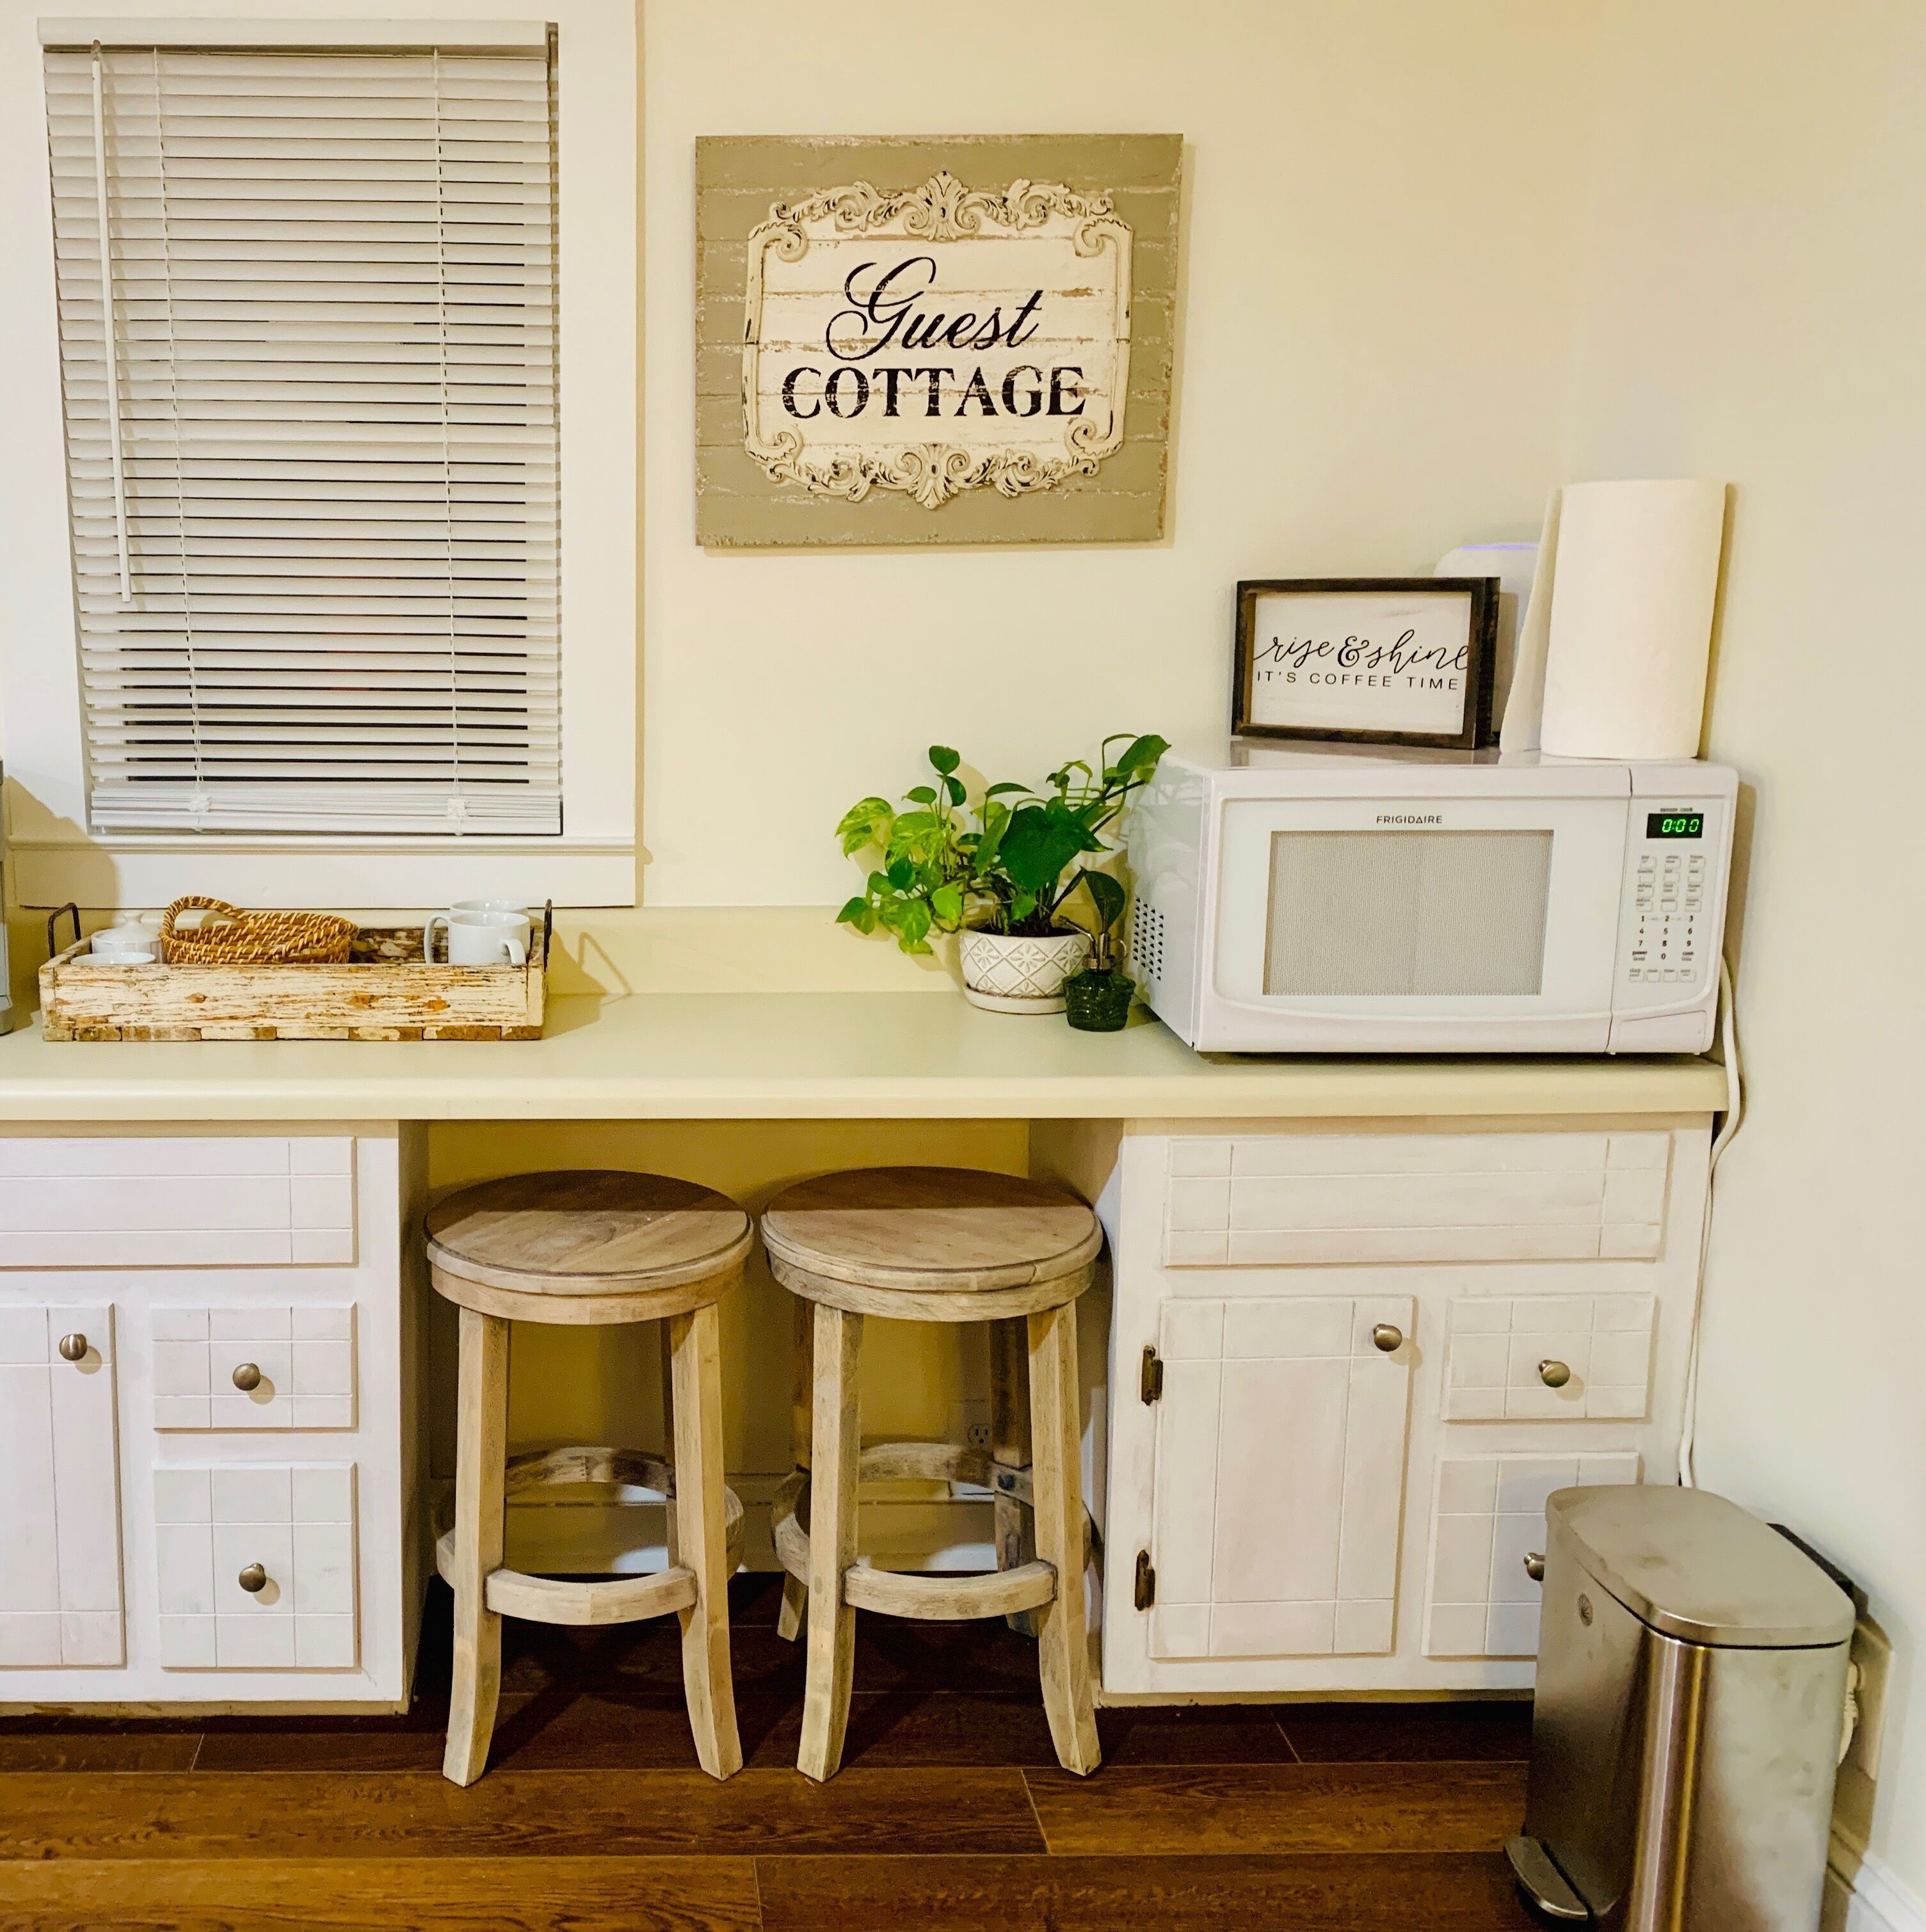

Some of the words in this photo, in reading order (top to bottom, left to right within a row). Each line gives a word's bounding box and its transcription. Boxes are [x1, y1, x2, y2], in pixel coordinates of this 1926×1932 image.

[826, 257, 1044, 361] Guest
[781, 365, 1086, 419] COTTAGE
[1253, 636, 1335, 667] rise
[1337, 635, 1369, 667] &
[1365, 629, 1468, 673] shine
[1257, 671, 1297, 683] IT'S
[1310, 673, 1392, 687] COFFEE
[1408, 676, 1459, 690] TIME
[1376, 815, 1442, 824] FRIGIDAIRE
[1662, 819, 1699, 833] 0:00
